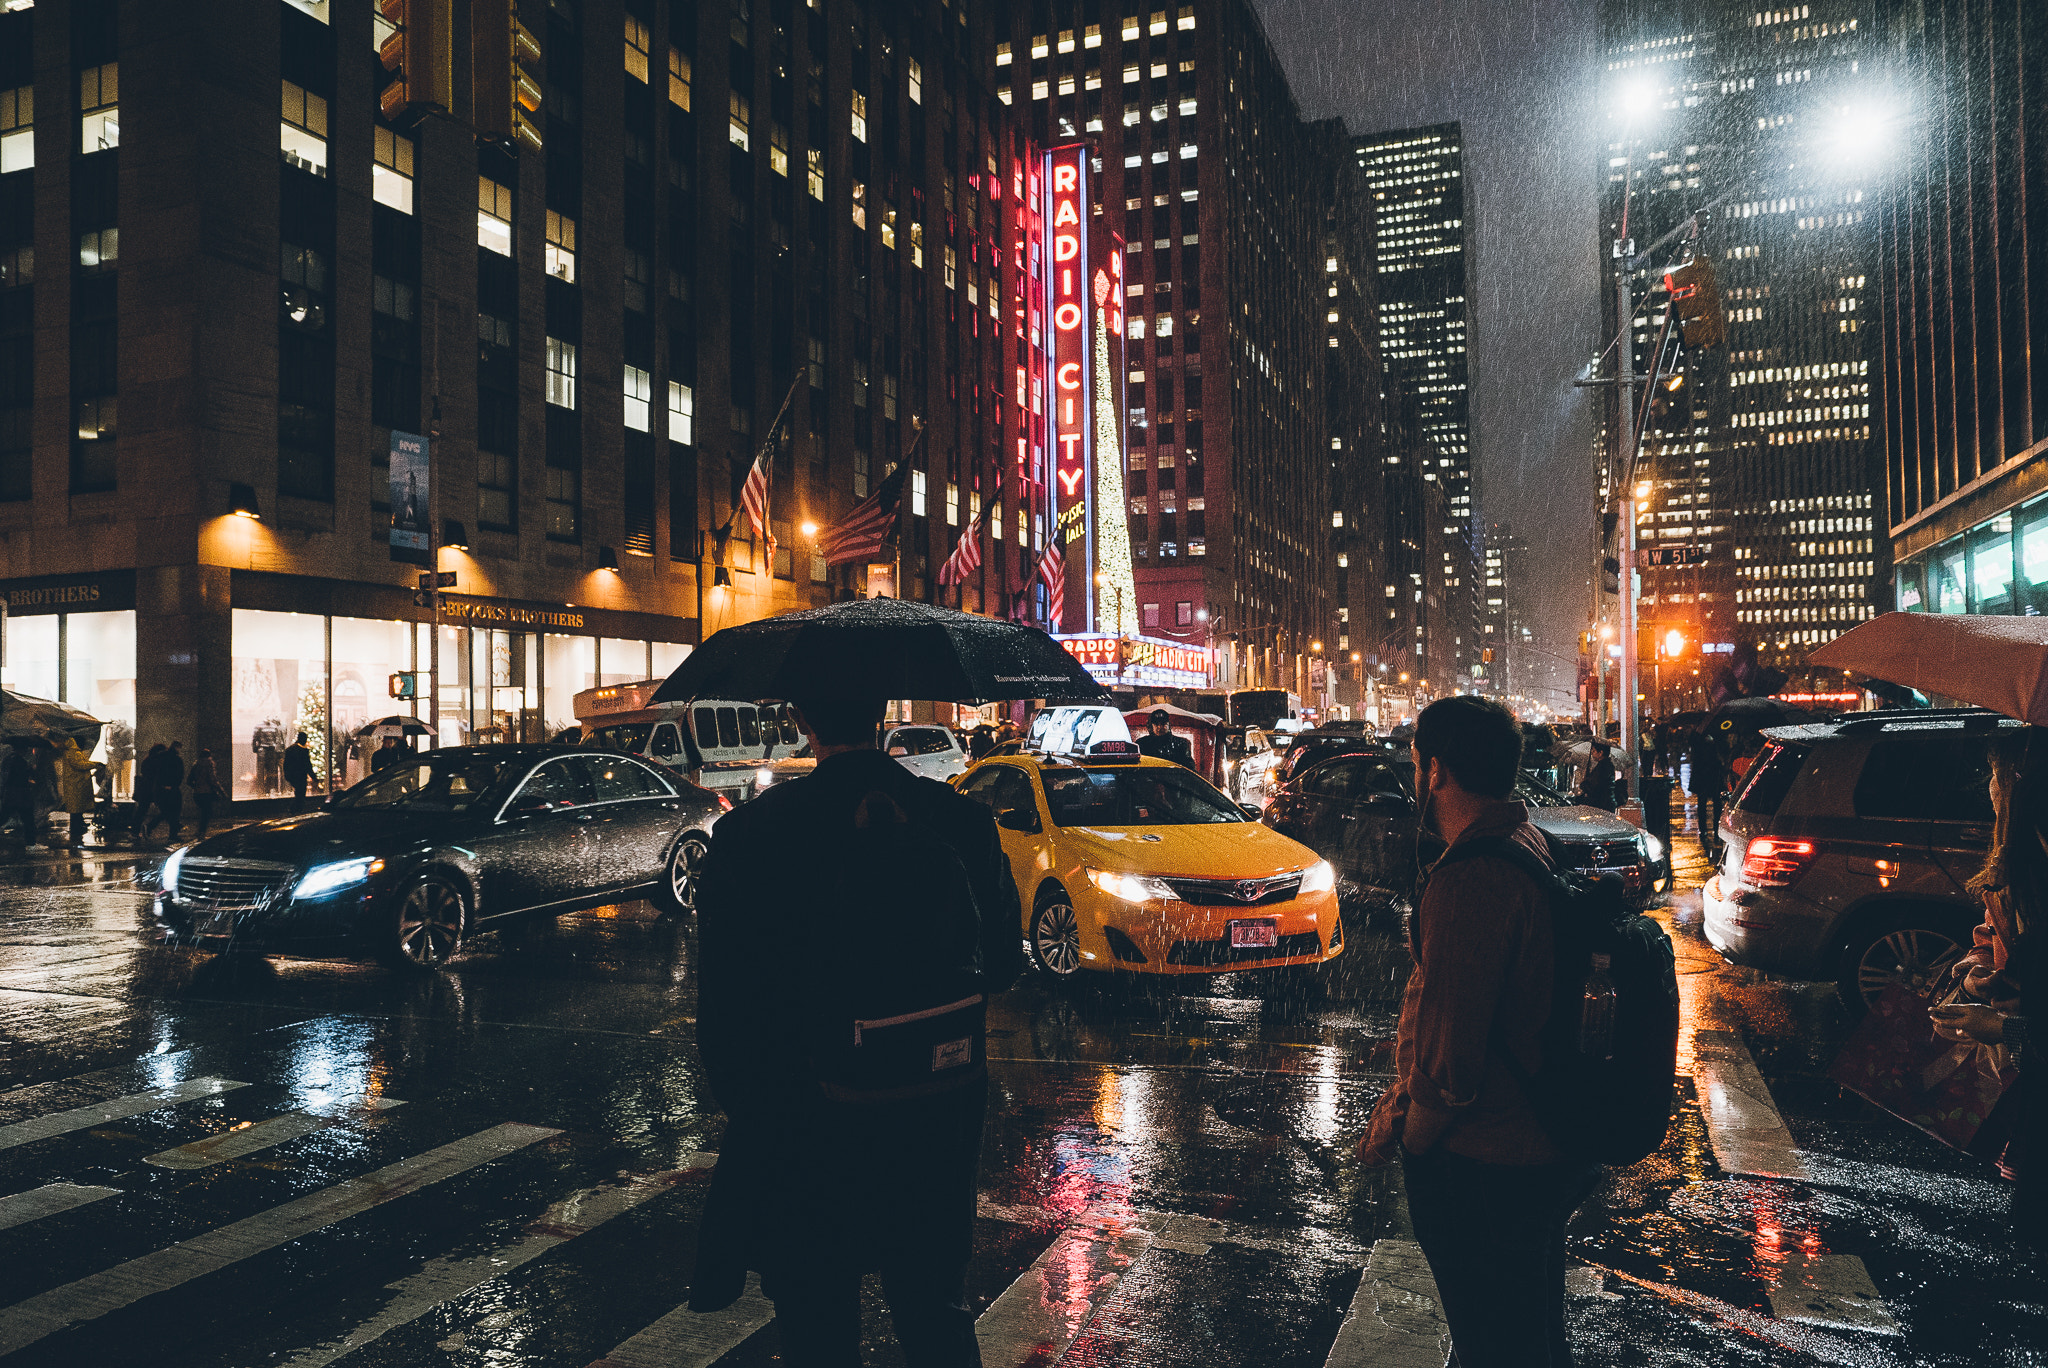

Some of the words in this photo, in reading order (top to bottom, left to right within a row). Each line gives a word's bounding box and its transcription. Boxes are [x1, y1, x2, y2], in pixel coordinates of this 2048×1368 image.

[1054, 164, 1082, 331] RADIO
[1057, 362, 1084, 496] CITY
[1651, 550, 1663, 565] W
[1672, 549, 1687, 564] 51
[1690, 548, 1700, 557] ST
[9, 585, 100, 606] BROTHERS
[446, 600, 507, 621] BROOKS
[510, 607, 584, 628] BROTHERS
[1063, 639, 1117, 652] RADIO
[1072, 651, 1116, 664] ITY
[1154, 645, 1185, 671] RADIO
[1187, 649, 1209, 673] CITY
[1091, 669, 1117, 678] HALL
[1101, 741, 1126, 753] 3M98
